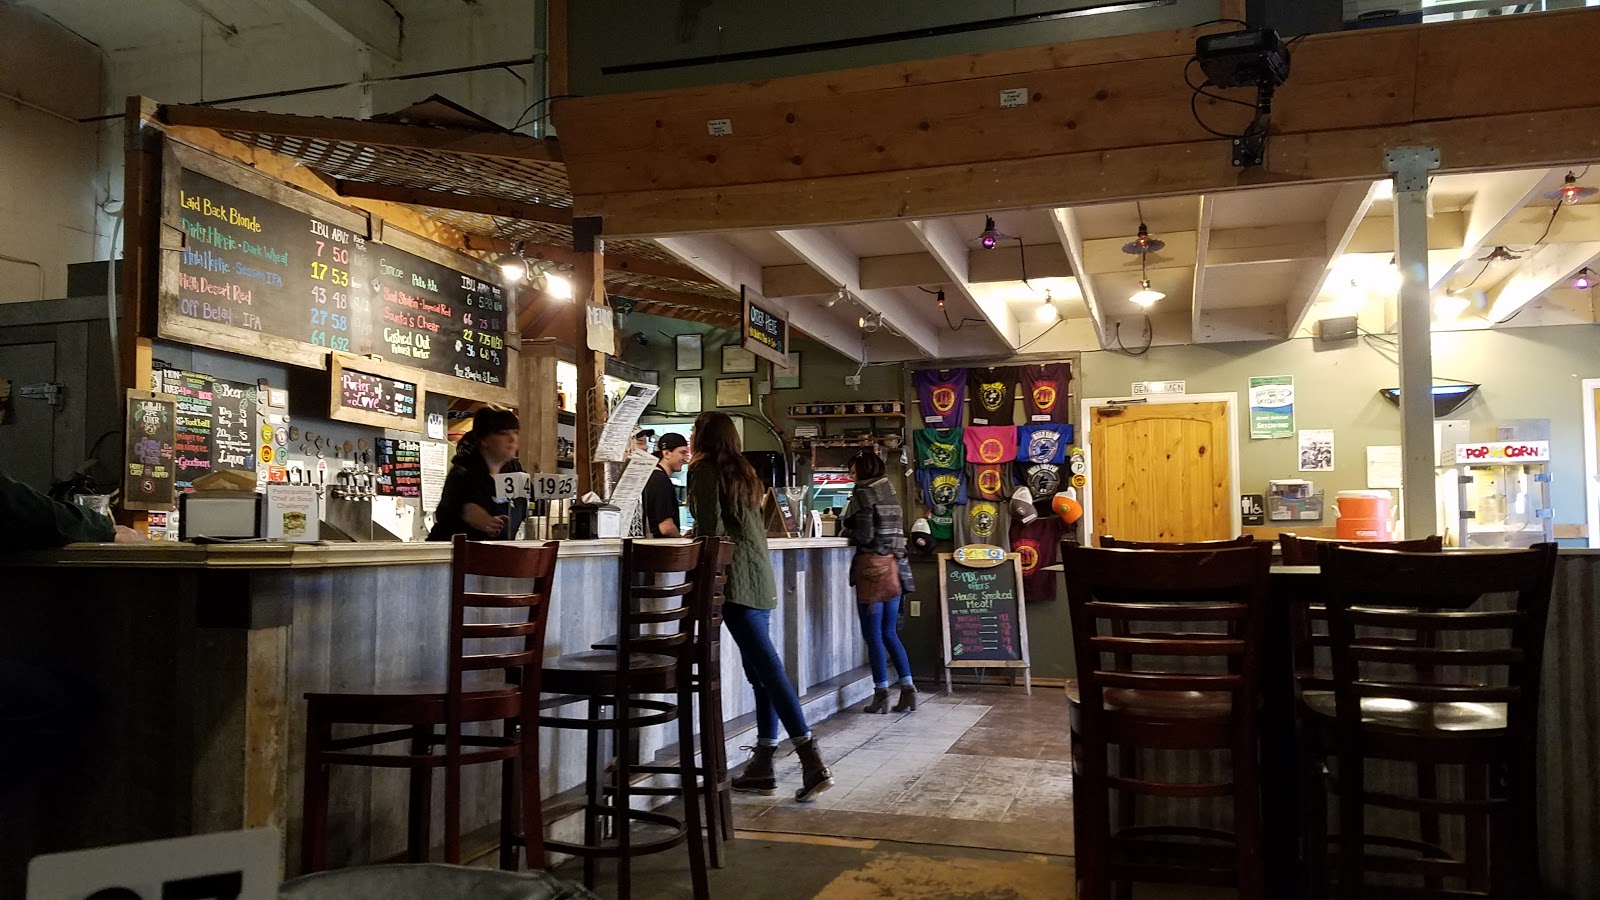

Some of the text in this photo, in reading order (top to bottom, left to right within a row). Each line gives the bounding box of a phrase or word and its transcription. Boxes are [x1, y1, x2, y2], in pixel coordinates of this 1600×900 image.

[180, 190, 262, 233] Laid Back Blonde
[309, 219, 329, 239] IBU
[180, 217, 207, 243] Dirty
[242, 240, 262, 256] Dark
[264, 246, 289, 267] Wheat
[315, 240, 325, 257] 7
[265, 271, 283, 288] IPA
[310, 261, 328, 280] 17
[179, 272, 252, 306] High Desert Red
[311, 285, 327, 304] 43
[466, 293, 473, 306] 6
[180, 298, 263, 331] Off Belay IPA
[310, 307, 328, 326] 27
[417, 314, 440, 333] Cheer
[383, 327, 413, 346] Cashed
[415, 333, 431, 350] Out
[220, 383, 244, 399] Beer
[217, 450, 246, 468] Liquor
[1466, 445, 1539, 459] POP CORN
[504, 477, 515, 494] 3
[523, 478, 530, 494] 4
[538, 477, 556, 495] 19
[559, 477, 574, 495] 25
[953, 589, 1014, 601] House Smoked
